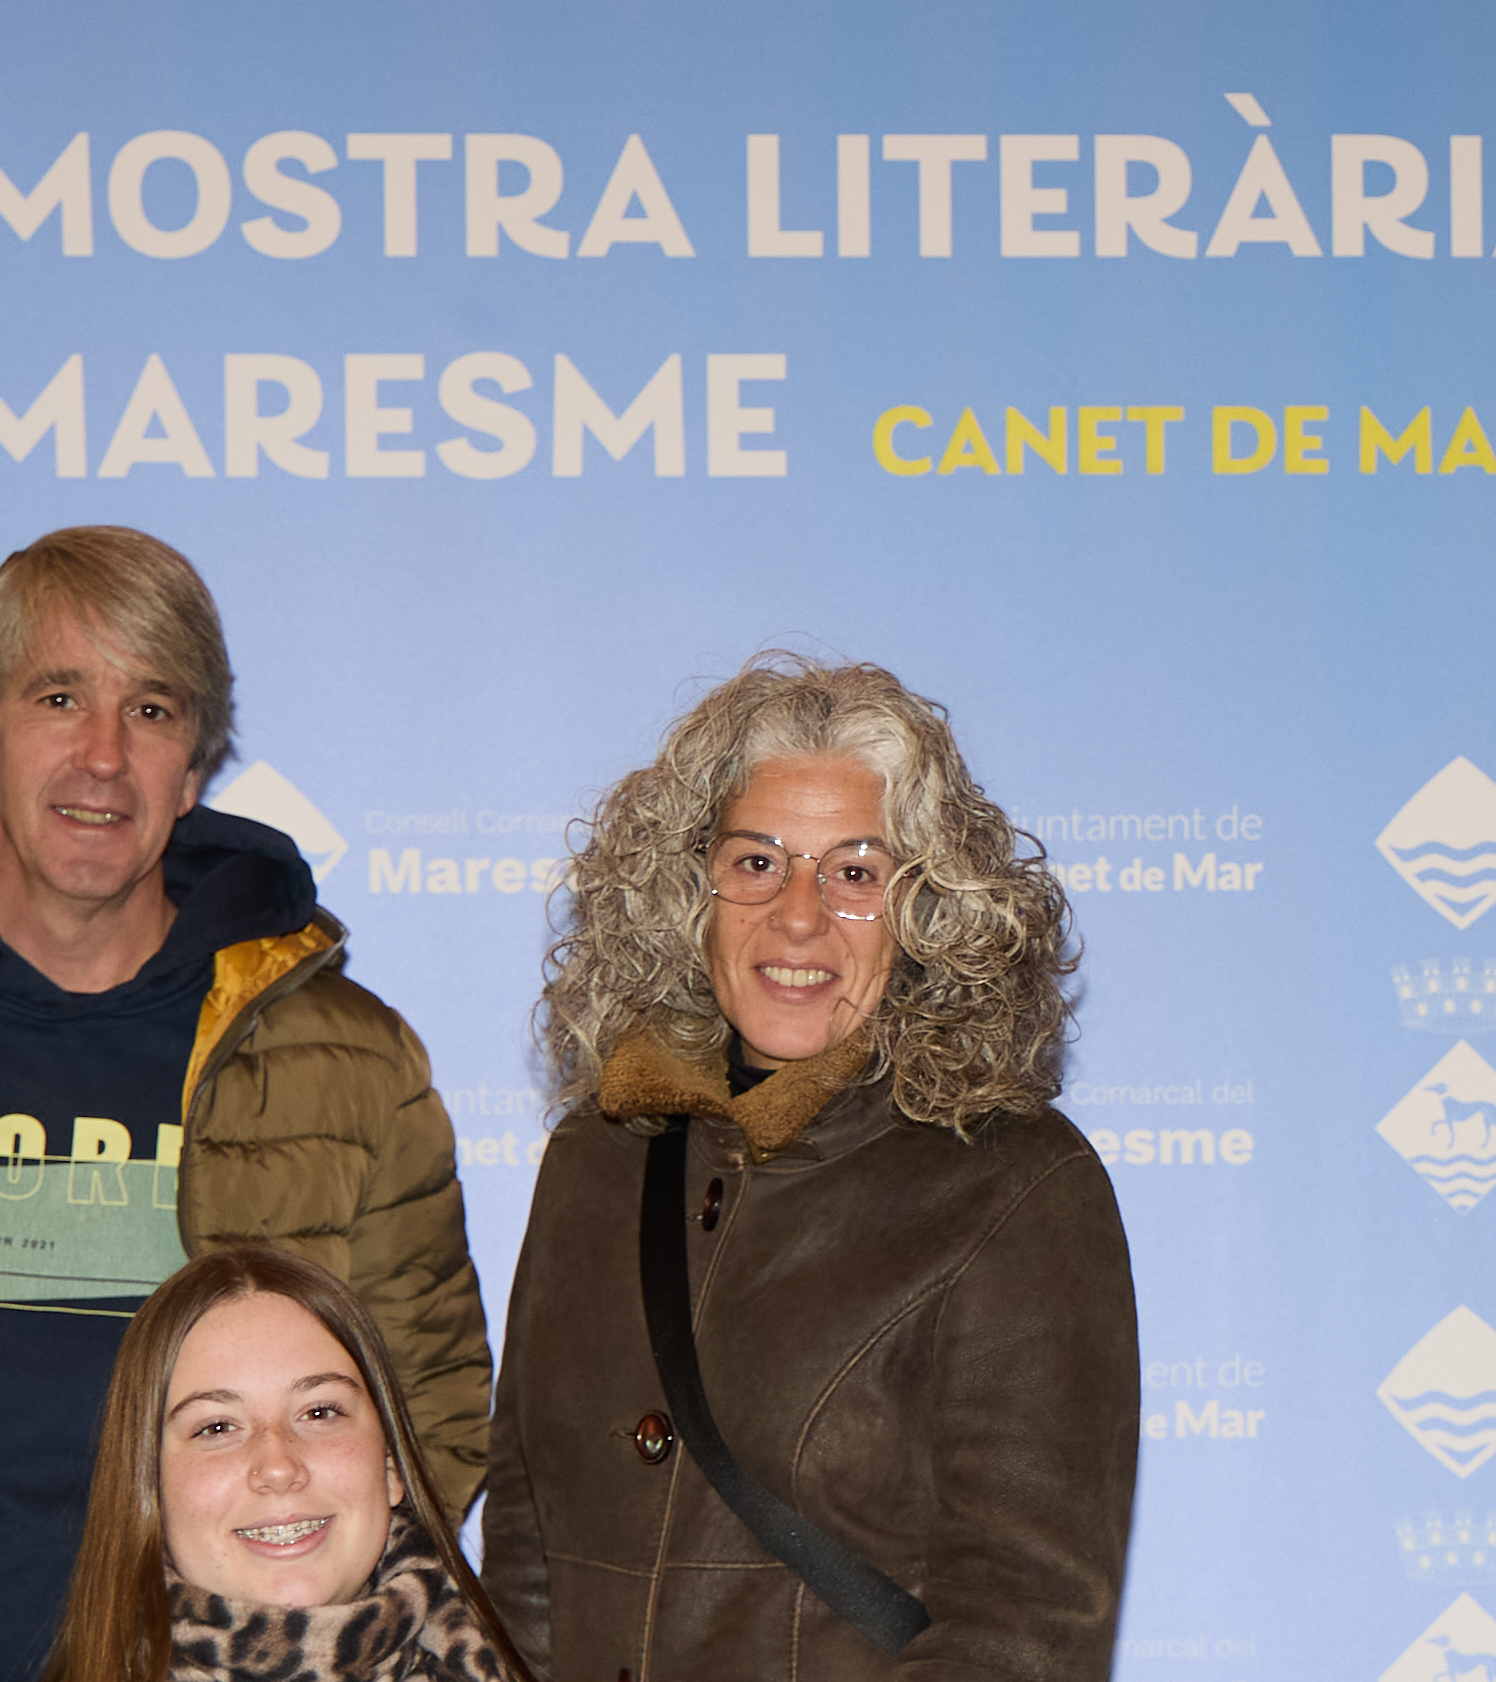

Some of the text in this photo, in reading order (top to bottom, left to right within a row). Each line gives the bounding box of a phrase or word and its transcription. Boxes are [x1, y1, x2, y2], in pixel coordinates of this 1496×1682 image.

[872, 404, 1185, 475] CANET
[1211, 404, 1329, 475] DE
[364, 809, 468, 835] Consell
[1215, 805, 1263, 841] de
[1120, 852, 1264, 892] de Mar
[1212, 1081, 1255, 1105] del
[1087, 1126, 1255, 1165] esme
[1175, 1400, 1265, 1438] Mar
